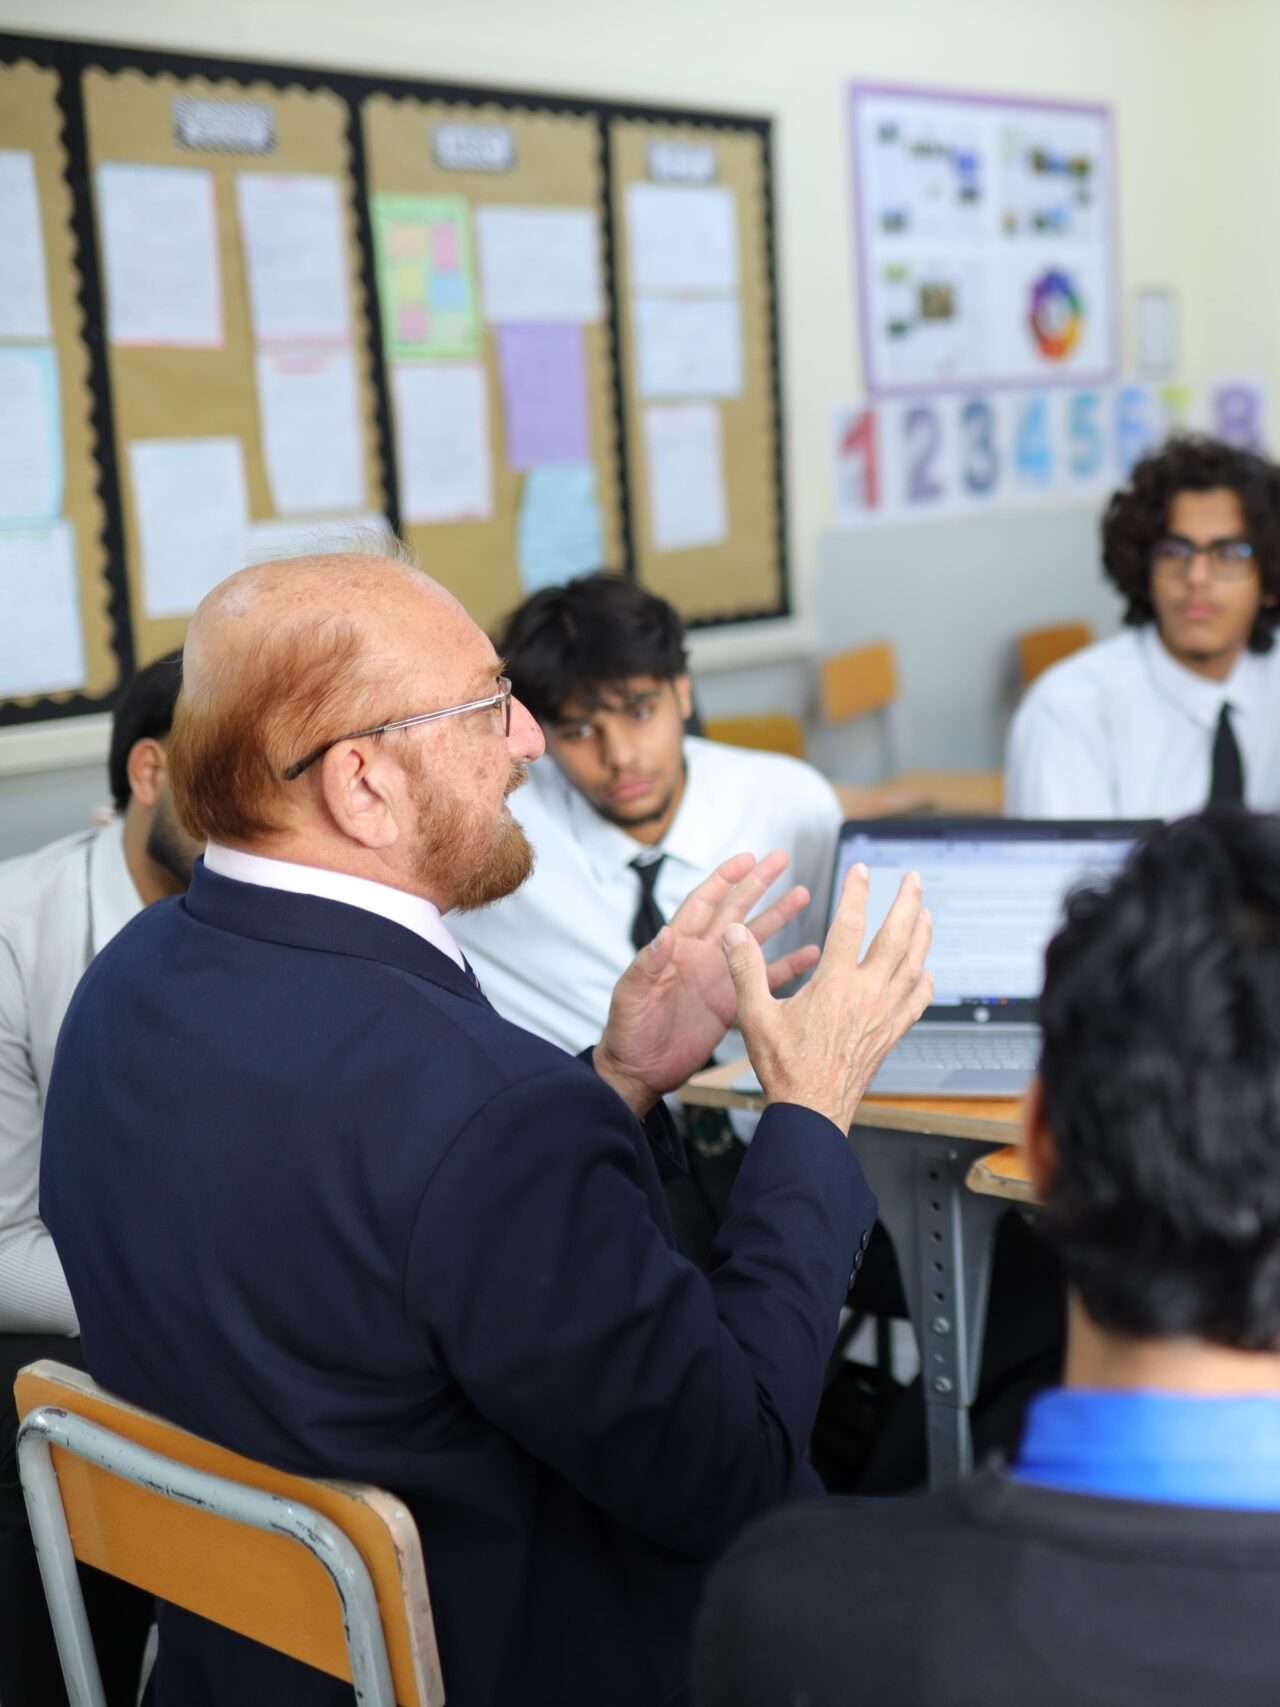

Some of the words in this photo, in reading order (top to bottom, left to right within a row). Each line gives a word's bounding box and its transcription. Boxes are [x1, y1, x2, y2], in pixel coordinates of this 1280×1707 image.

[840, 408, 880, 511] 1
[904, 406, 942, 506] 2
[961, 396, 997, 495] 3
[1015, 389, 1052, 488] 4
[1070, 390, 1103, 478] 5
